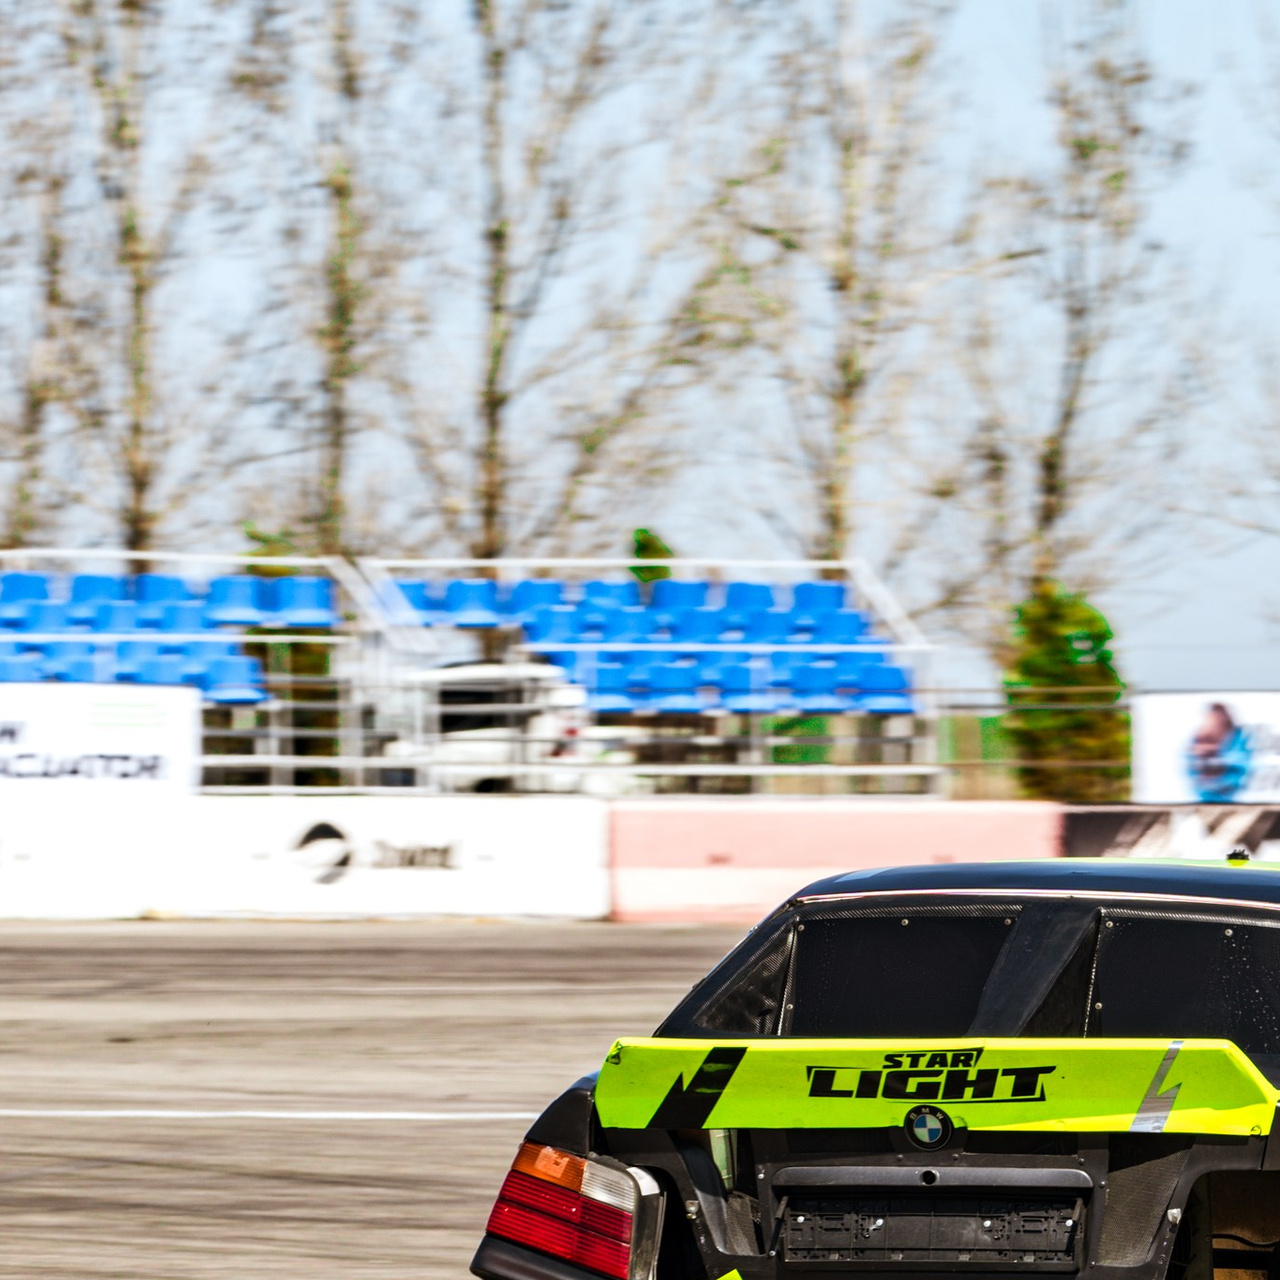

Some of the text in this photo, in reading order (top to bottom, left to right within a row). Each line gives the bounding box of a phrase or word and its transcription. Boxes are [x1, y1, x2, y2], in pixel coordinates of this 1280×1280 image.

[883, 1052, 974, 1069] STAR
[808, 1066, 1057, 1100] LIGHT
[910, 1107, 944, 1120] BMW
